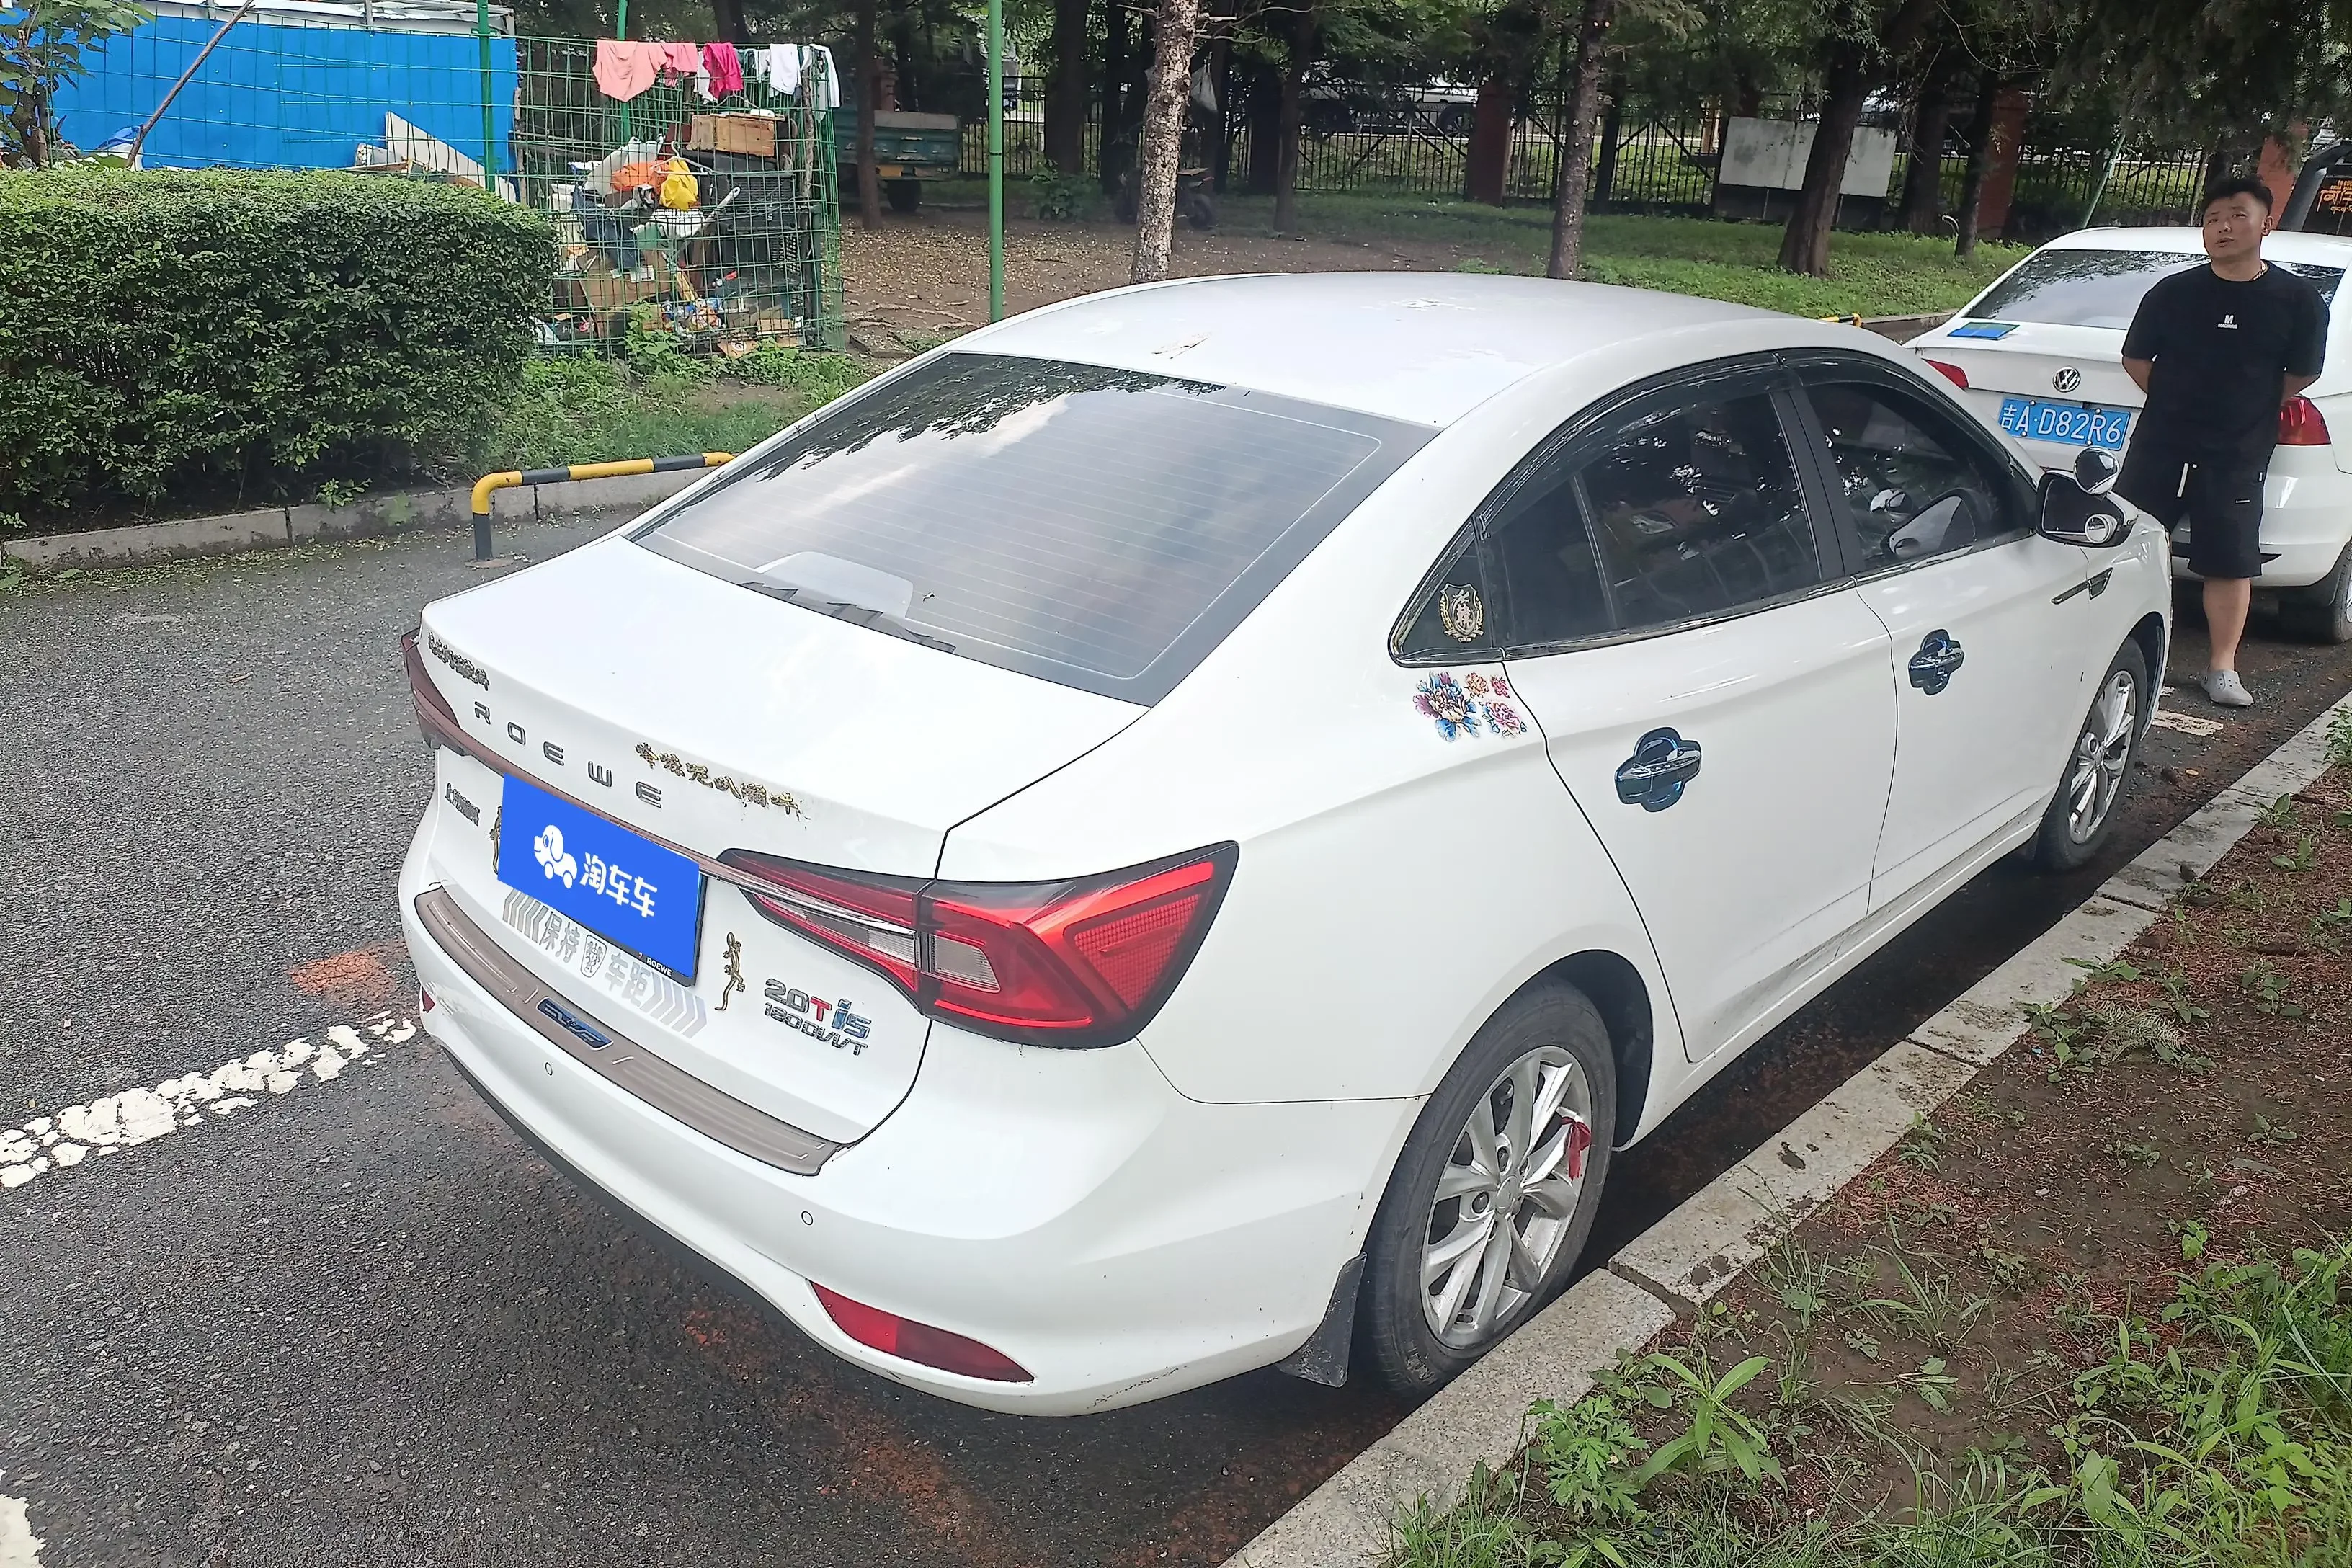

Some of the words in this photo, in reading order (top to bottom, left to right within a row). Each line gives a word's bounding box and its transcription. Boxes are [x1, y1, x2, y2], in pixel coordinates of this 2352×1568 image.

[2224, 314, 2234, 324] M
[474, 700, 662, 808] ROEWE
[539, 910, 580, 963] 保持
[605, 952, 652, 1007] 车距
[646, 956, 673, 977] ROEWE
